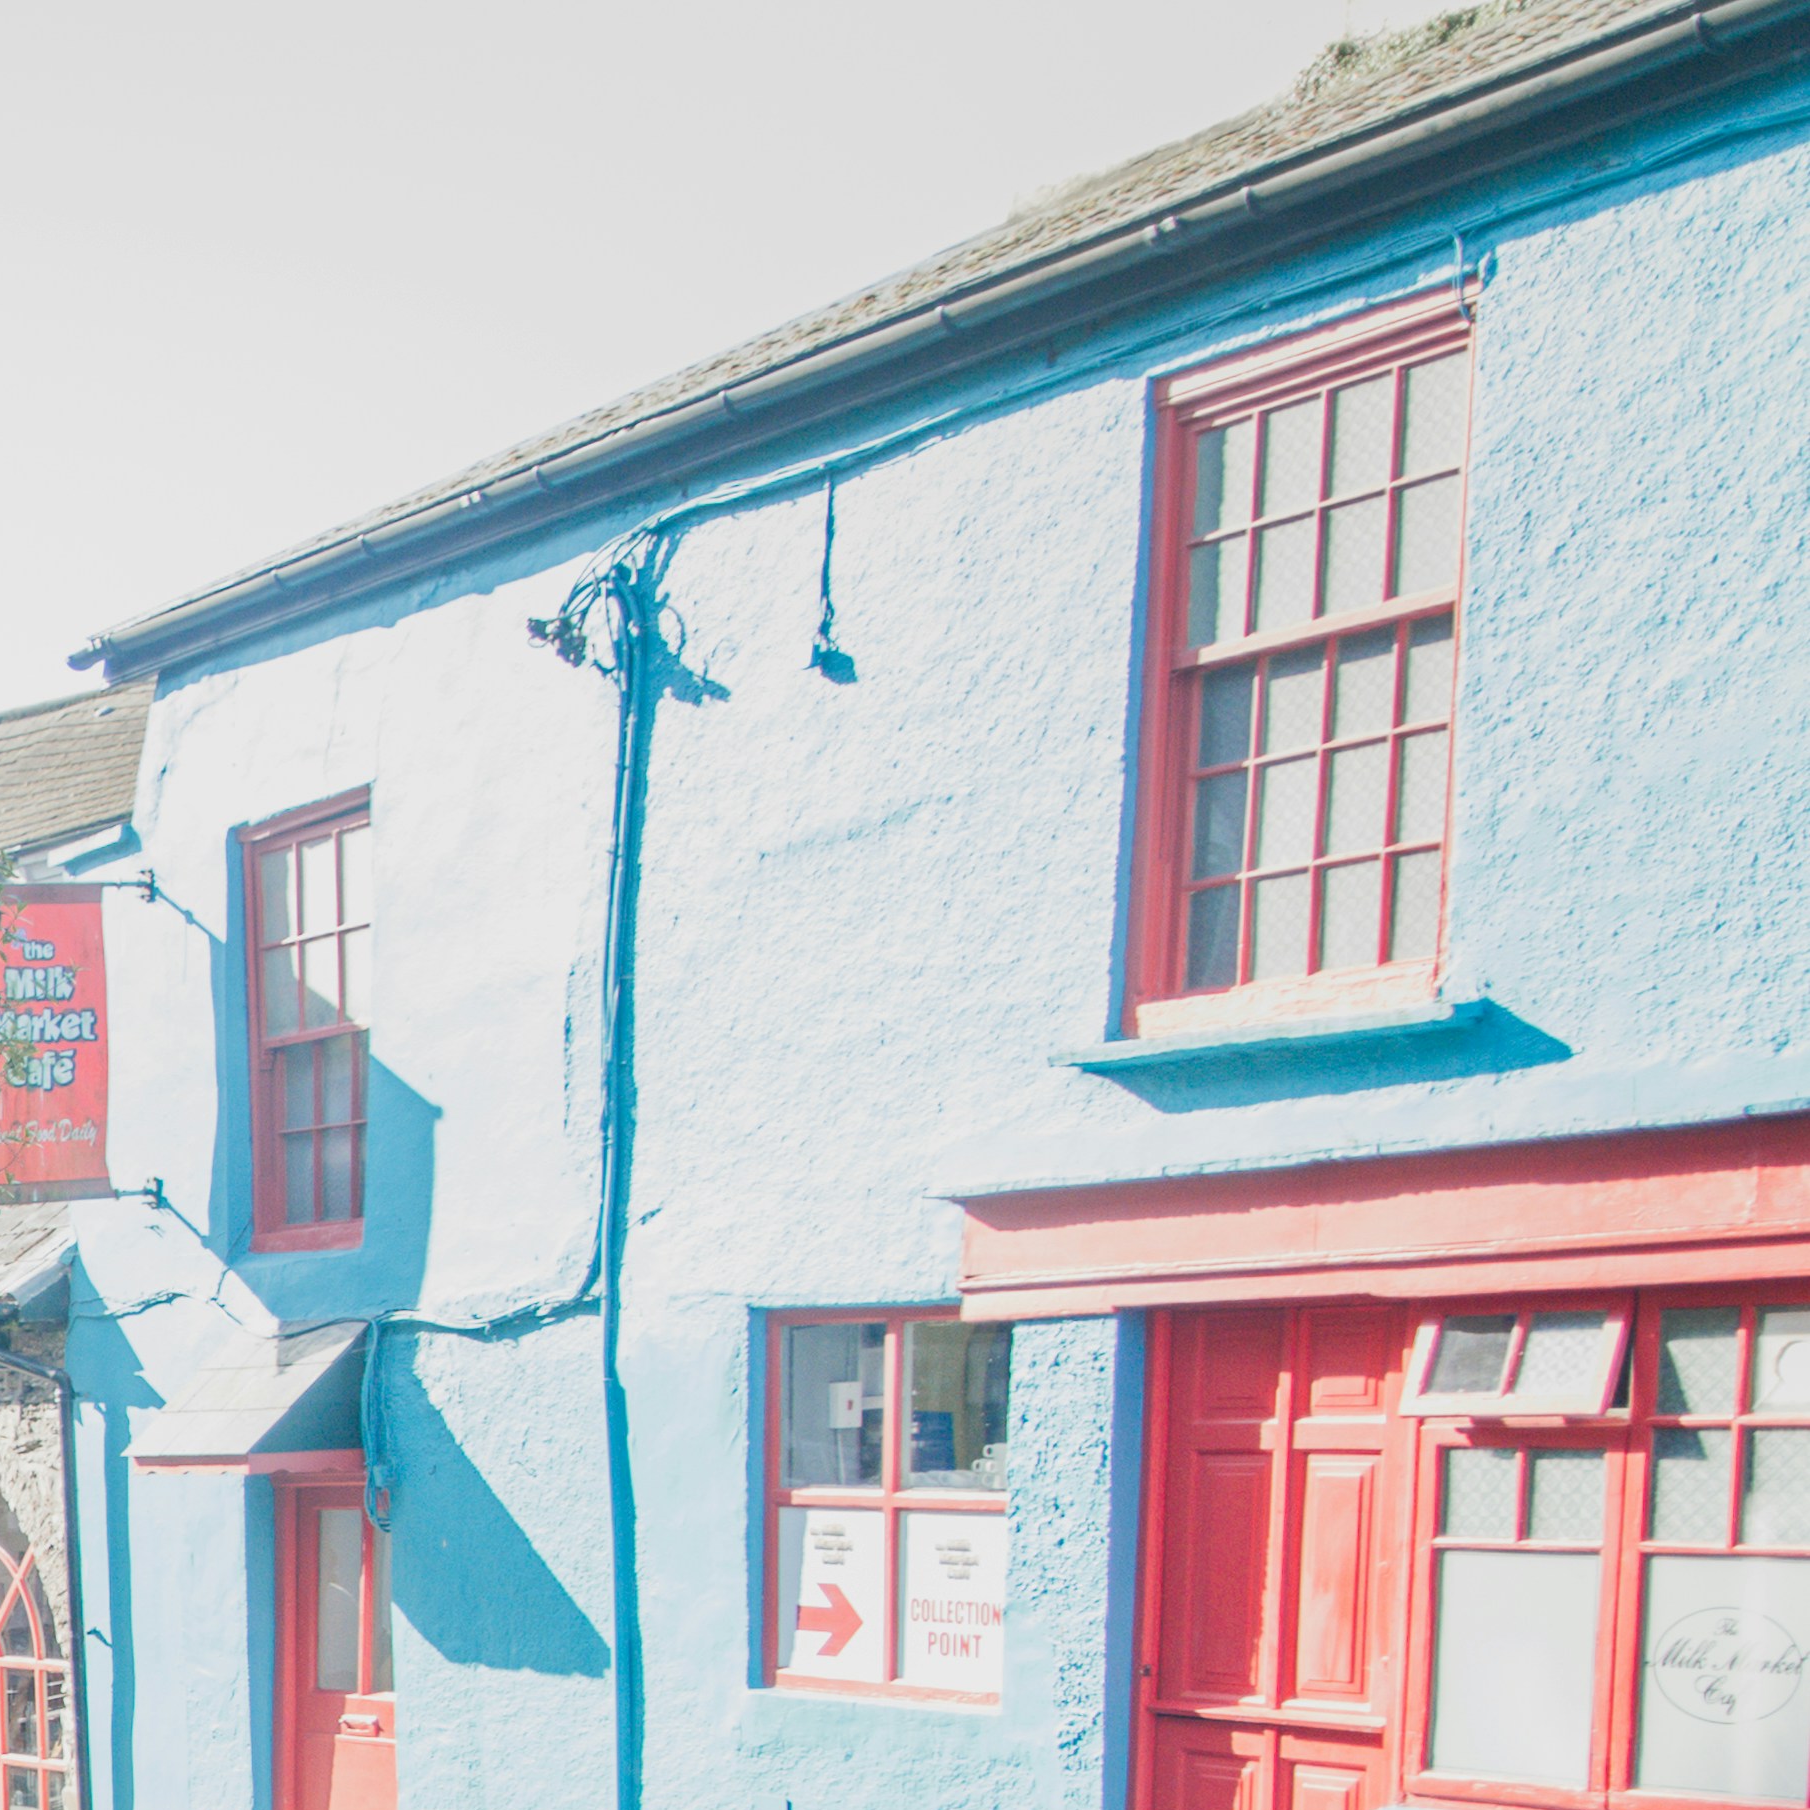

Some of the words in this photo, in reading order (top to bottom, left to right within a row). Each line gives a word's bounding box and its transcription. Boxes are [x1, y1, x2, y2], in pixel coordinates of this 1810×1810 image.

[24, 939, 55, 961] the
[4, 966, 76, 1001] Milk
[58, 1118, 98, 1147] Daily
[910, 1598, 1002, 1627] COLLECTION
[928, 1631, 983, 1659] POINT
[1648, 1636, 1718, 1671] Milk
[1710, 1641, 1810, 1676] Mrket
